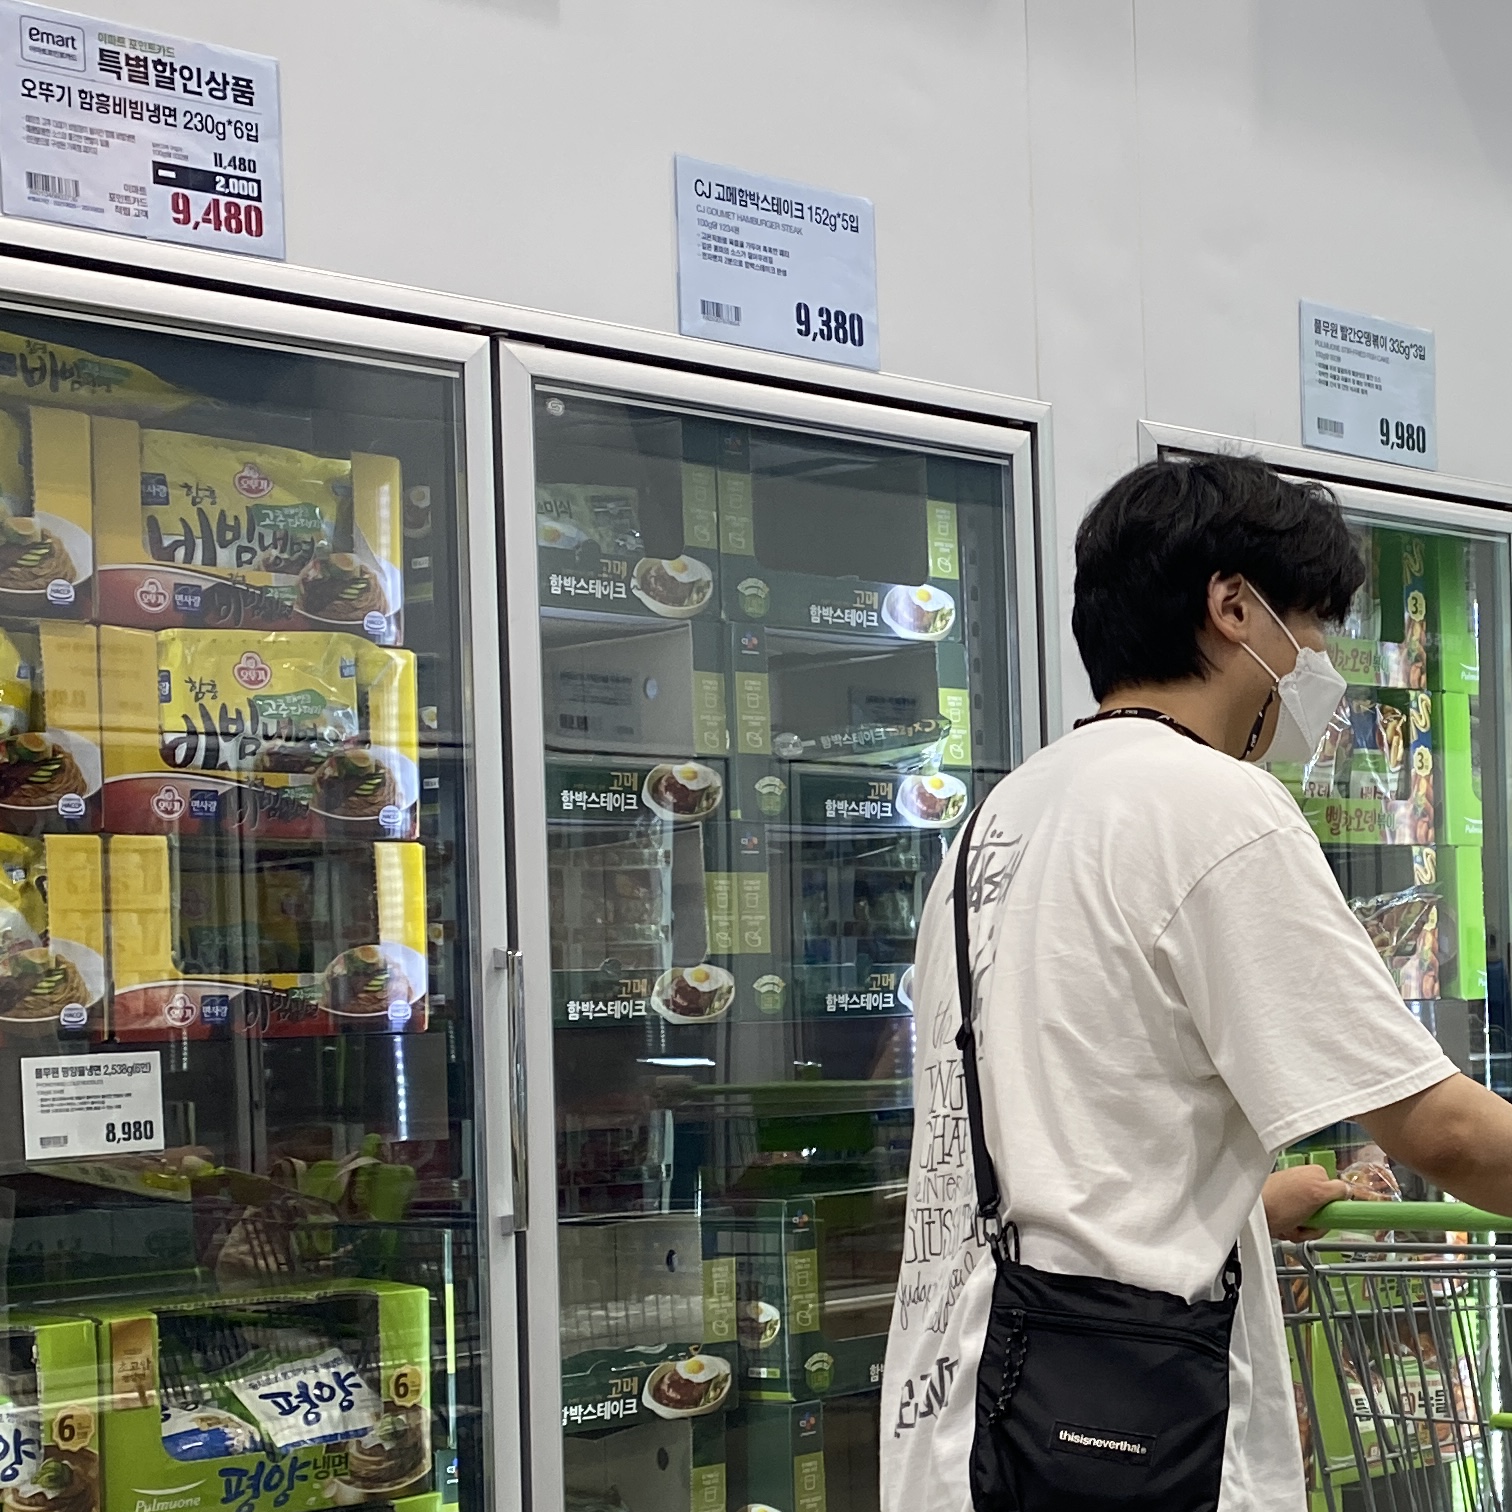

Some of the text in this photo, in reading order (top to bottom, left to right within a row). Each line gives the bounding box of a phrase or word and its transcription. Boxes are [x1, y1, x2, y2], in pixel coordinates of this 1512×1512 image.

[28, 26, 77, 50] emart
[97, 47, 255, 107] 특별할인상품
[21, 78, 72, 108] 오뚜기
[77, 88, 178, 128] 함흥비빔냉면
[213, 152, 257, 174] 11,480
[215, 176, 259, 197] 2,000
[694, 178, 712, 199] CJ
[715, 183, 805, 220] 고메함박스테이크
[170, 192, 264, 238] 9,480
[795, 302, 864, 347] 9,380
[1379, 417, 1427, 454] 9,980
[548, 573, 628, 600] 함박스테이크
[809, 605, 880, 628] 함박스테이크
[1417, 752, 1426, 770] 3
[608, 772, 638, 791] 고메
[867, 782, 893, 800] 고메
[560, 790, 639, 811] 함박스테이크
[824, 799, 893, 818] 함박스테이크
[618, 979, 648, 997] 고메
[869, 973, 895, 990] 고메
[567, 1000, 647, 1021] 함박스테이크
[825, 993, 896, 1011] 함박스테이크
[105, 1120, 154, 1143] 8,980
[394, 1373, 409, 1398] 6
[608, 1378, 639, 1397] 고메
[258, 1371, 362, 1427] 평양
[58, 1414, 76, 1441] 6
[1059, 1430, 1141, 1454] thisisneverthat
